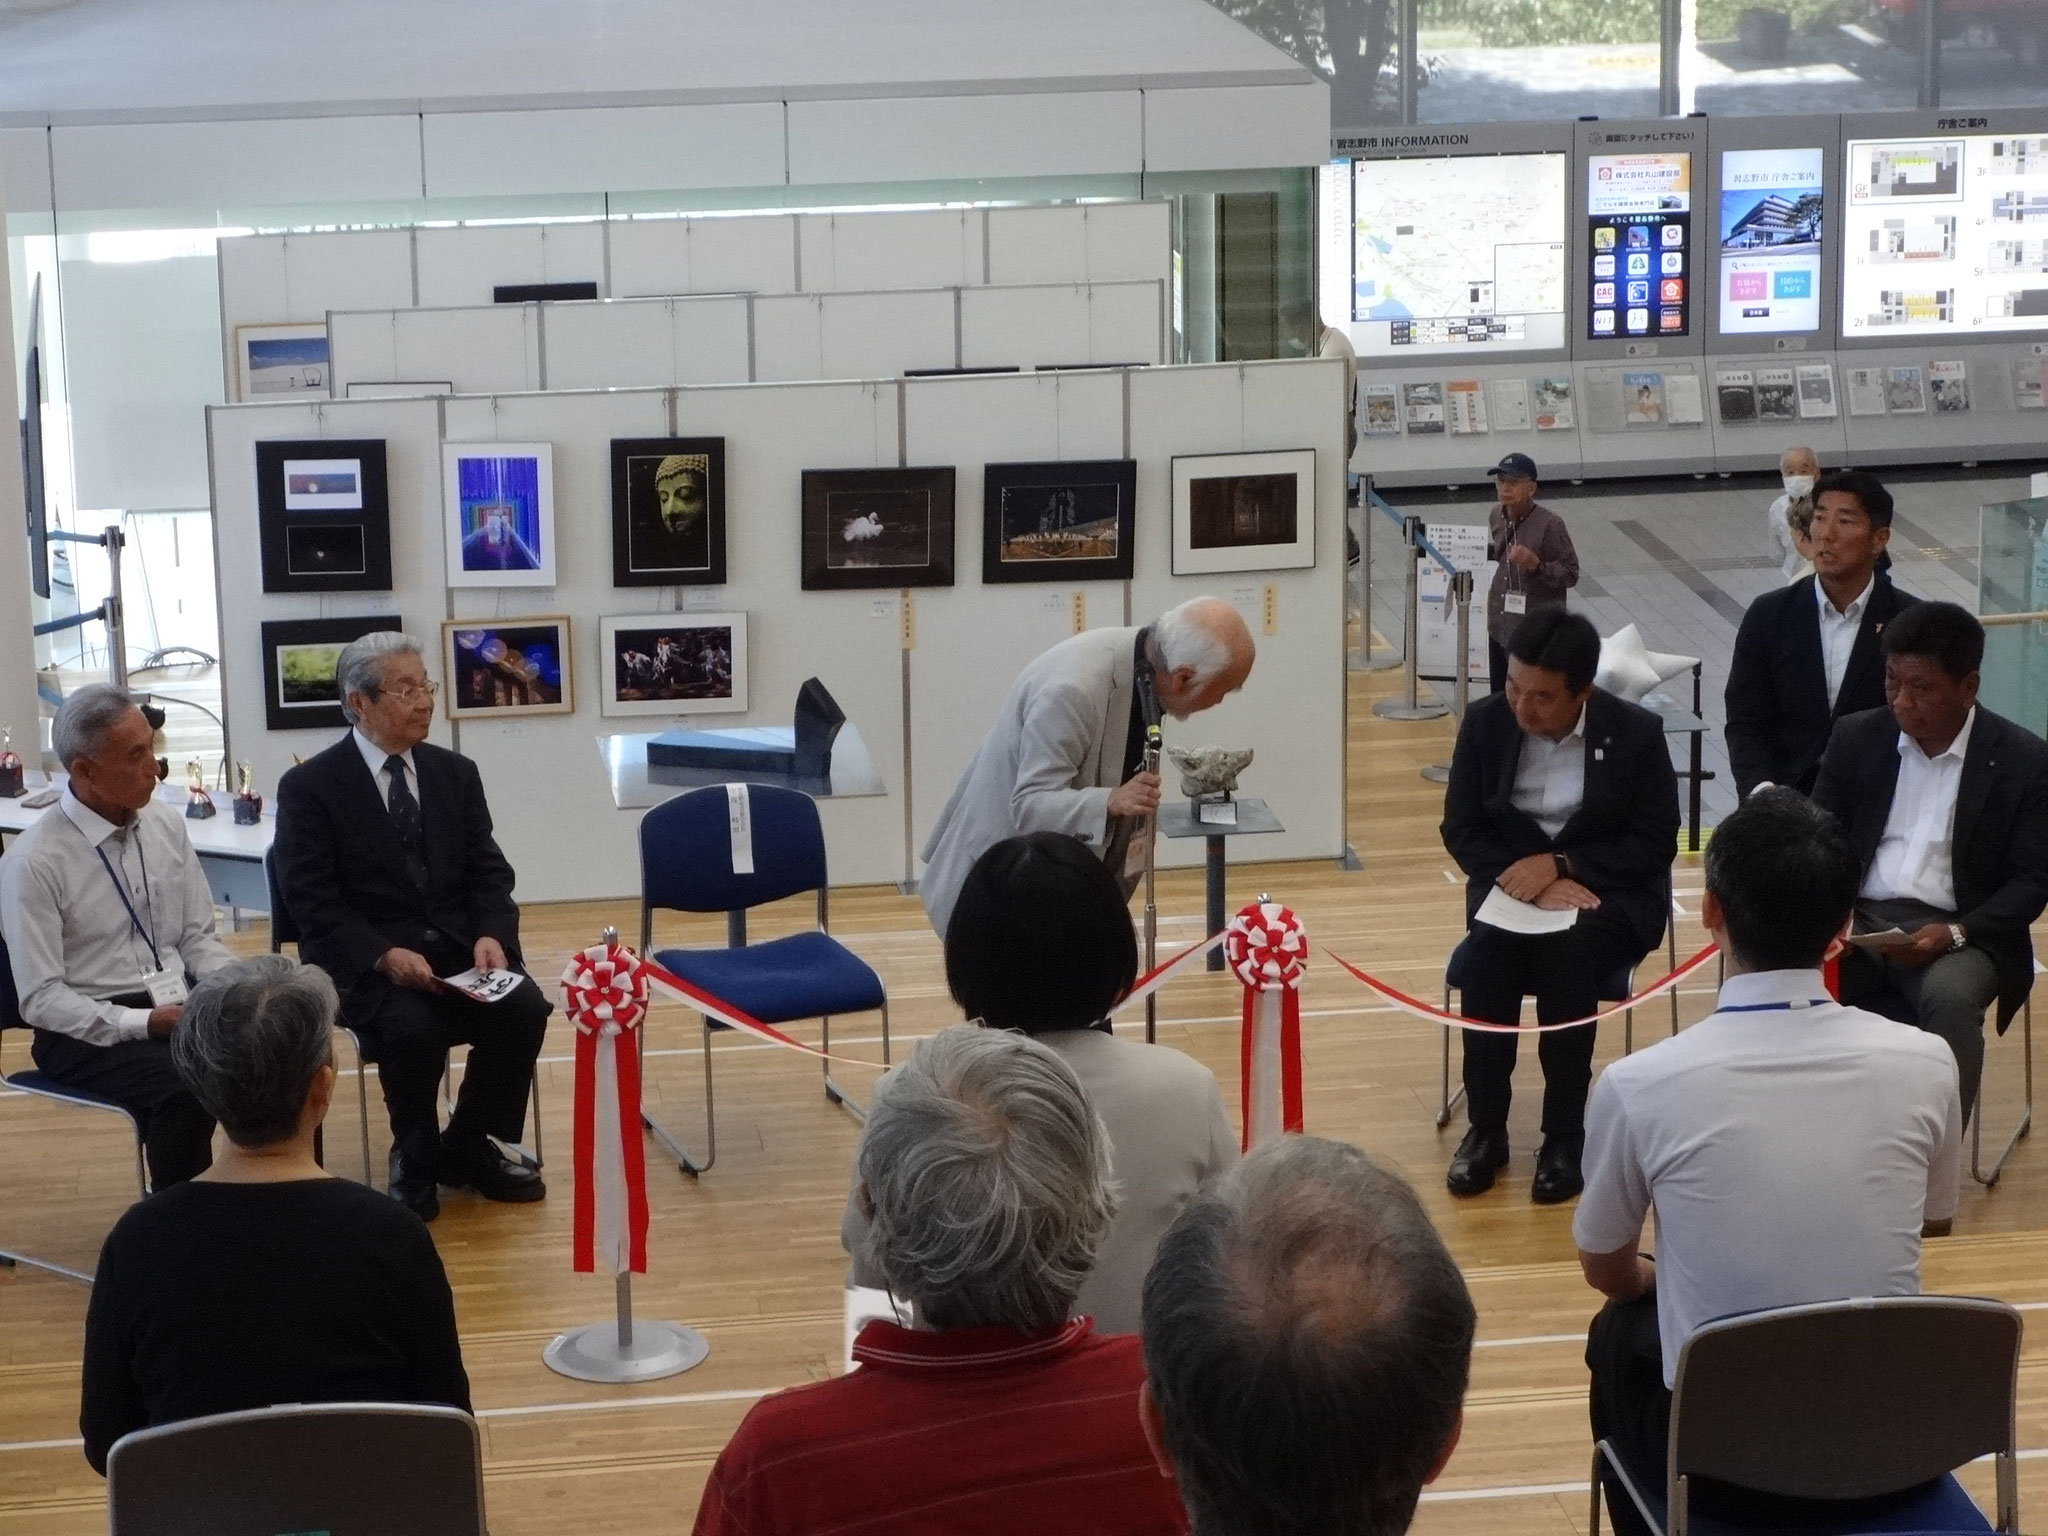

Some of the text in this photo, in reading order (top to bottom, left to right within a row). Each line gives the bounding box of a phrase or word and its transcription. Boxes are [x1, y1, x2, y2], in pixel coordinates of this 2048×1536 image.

[1937, 118, 1988, 129] 庁舎ご案内
[1381, 134, 1469, 148] INFORMATION
[1976, 167, 1988, 176] 3F
[1855, 183, 1868, 193] GF
[1974, 267, 1985, 276] 5F
[1596, 287, 1613, 296] CAC
[1854, 317, 1865, 327] 2F
[1972, 317, 1983, 326] 6F
